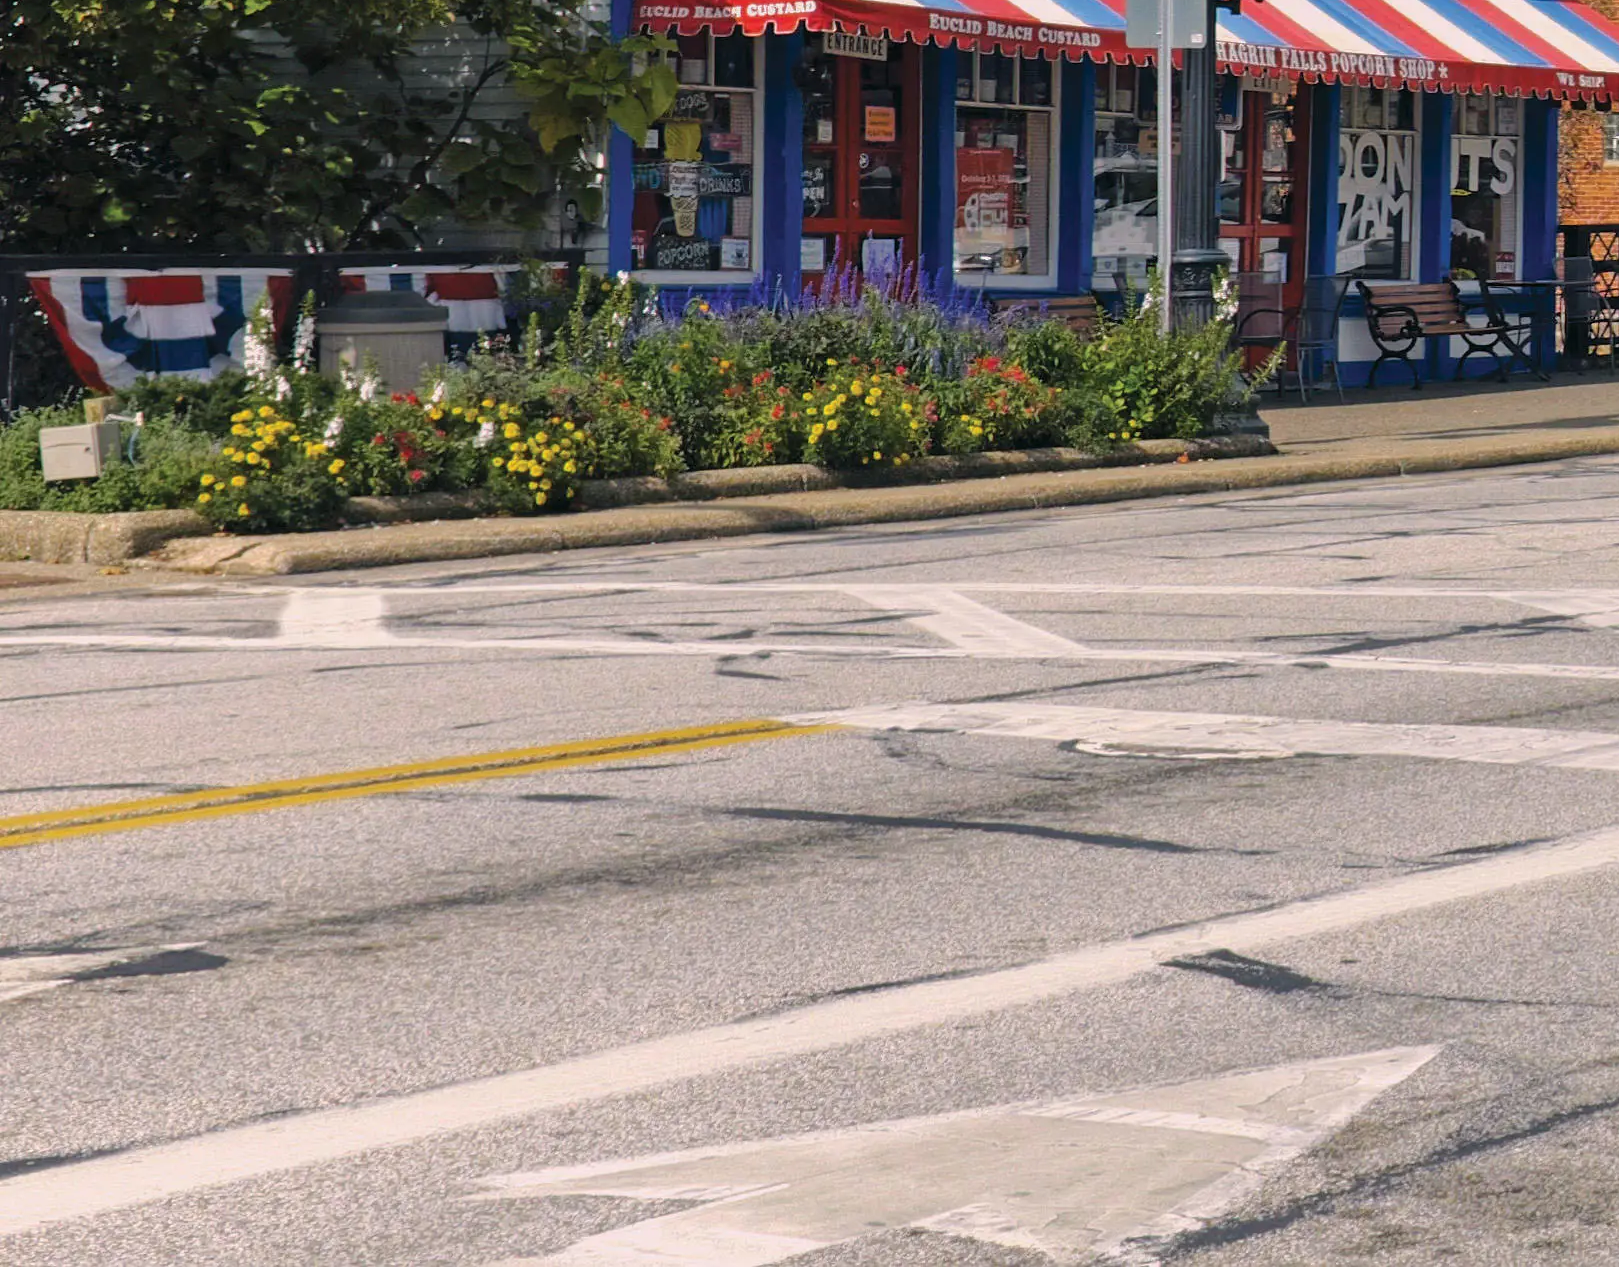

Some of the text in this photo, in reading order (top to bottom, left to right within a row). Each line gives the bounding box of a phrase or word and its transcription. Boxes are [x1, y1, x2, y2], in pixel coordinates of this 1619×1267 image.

[640, 0, 817, 19] EUCLID BEACH CUSTARD
[929, 13, 1101, 47] EUCLID BEACH CUSTARD
[827, 34, 884, 57] ENTRANCE
[1215, 41, 1436, 80] HAGRIN FALLS POPCORN SHOP
[1556, 72, 1575, 87] WE
[699, 177, 742, 193] DRINKS
[802, 185, 825, 200] PEN
[1338, 186, 1411, 246] 7AM
[657, 242, 711, 267] POPCORN
